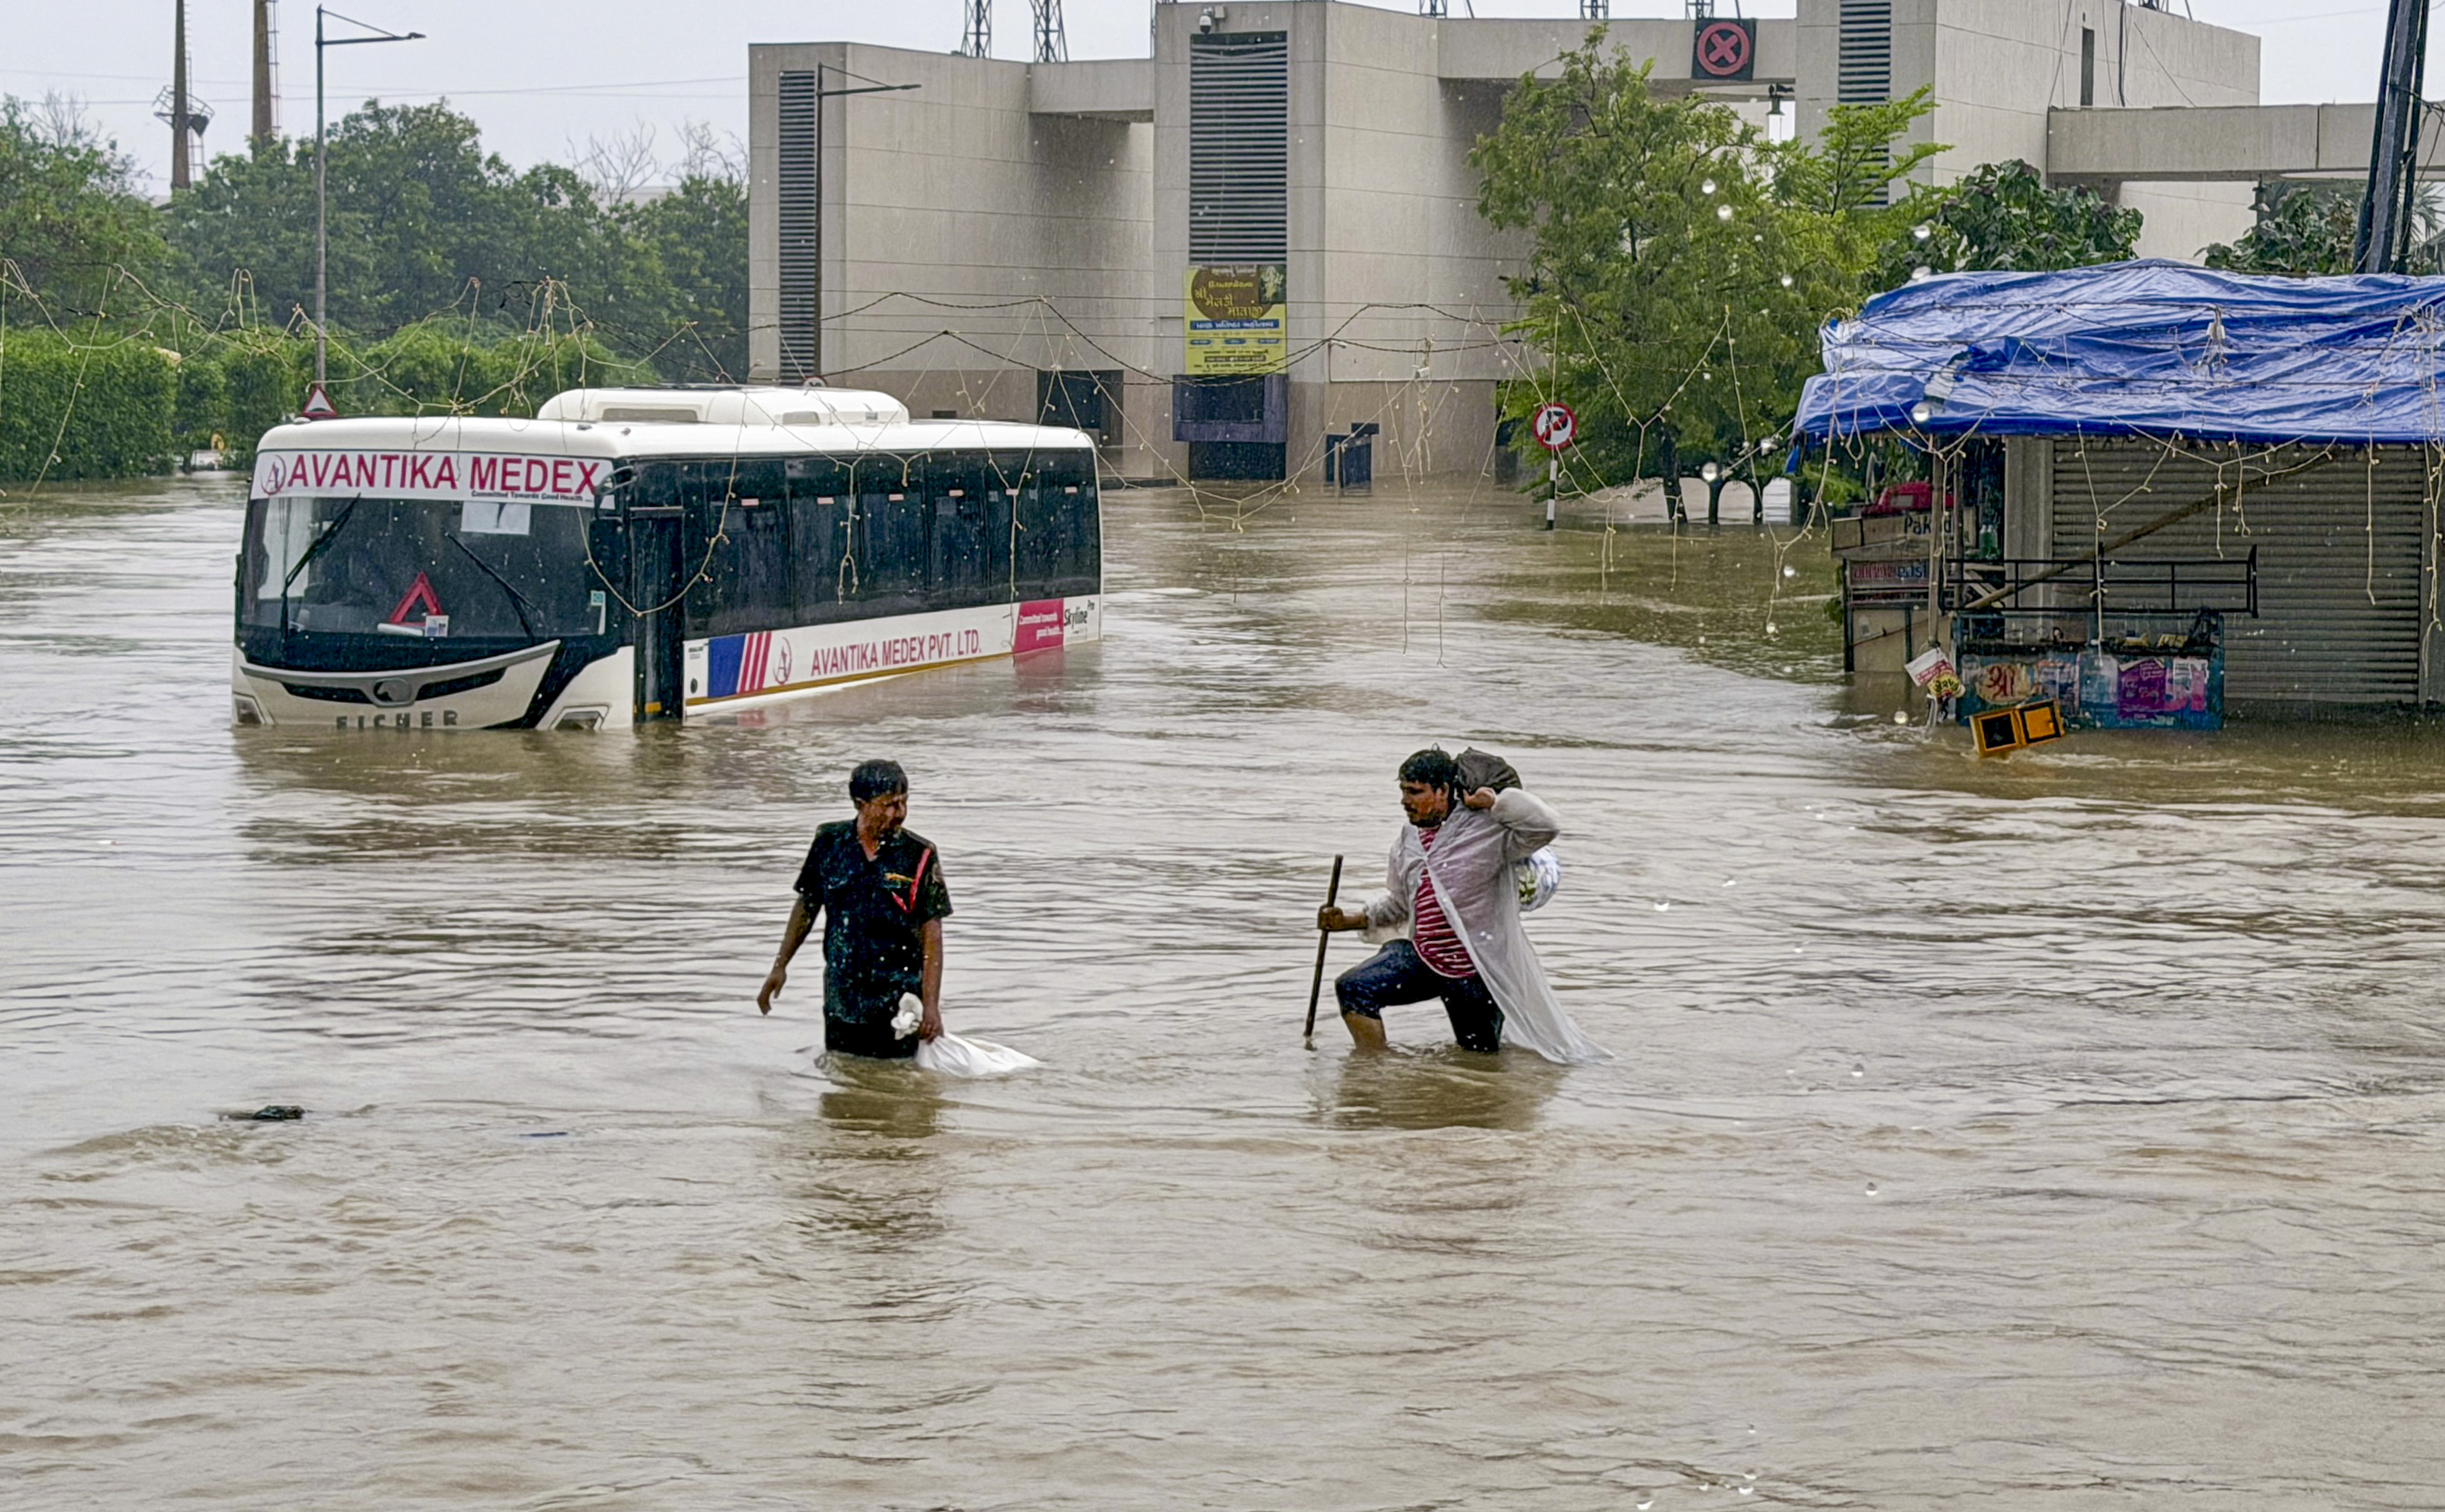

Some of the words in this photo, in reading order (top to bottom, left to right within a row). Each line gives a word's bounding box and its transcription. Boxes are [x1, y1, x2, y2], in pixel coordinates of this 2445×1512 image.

[288, 454, 457, 489] AVANTIKA
[470, 456, 600, 496] MEDEX
[810, 642, 879, 677] AVANTIKA
[882, 636, 926, 666] MEDEX
[928, 633, 954, 661] PVT.
[957, 629, 982, 656] LTD.
[336, 710, 458, 730] EICHER
